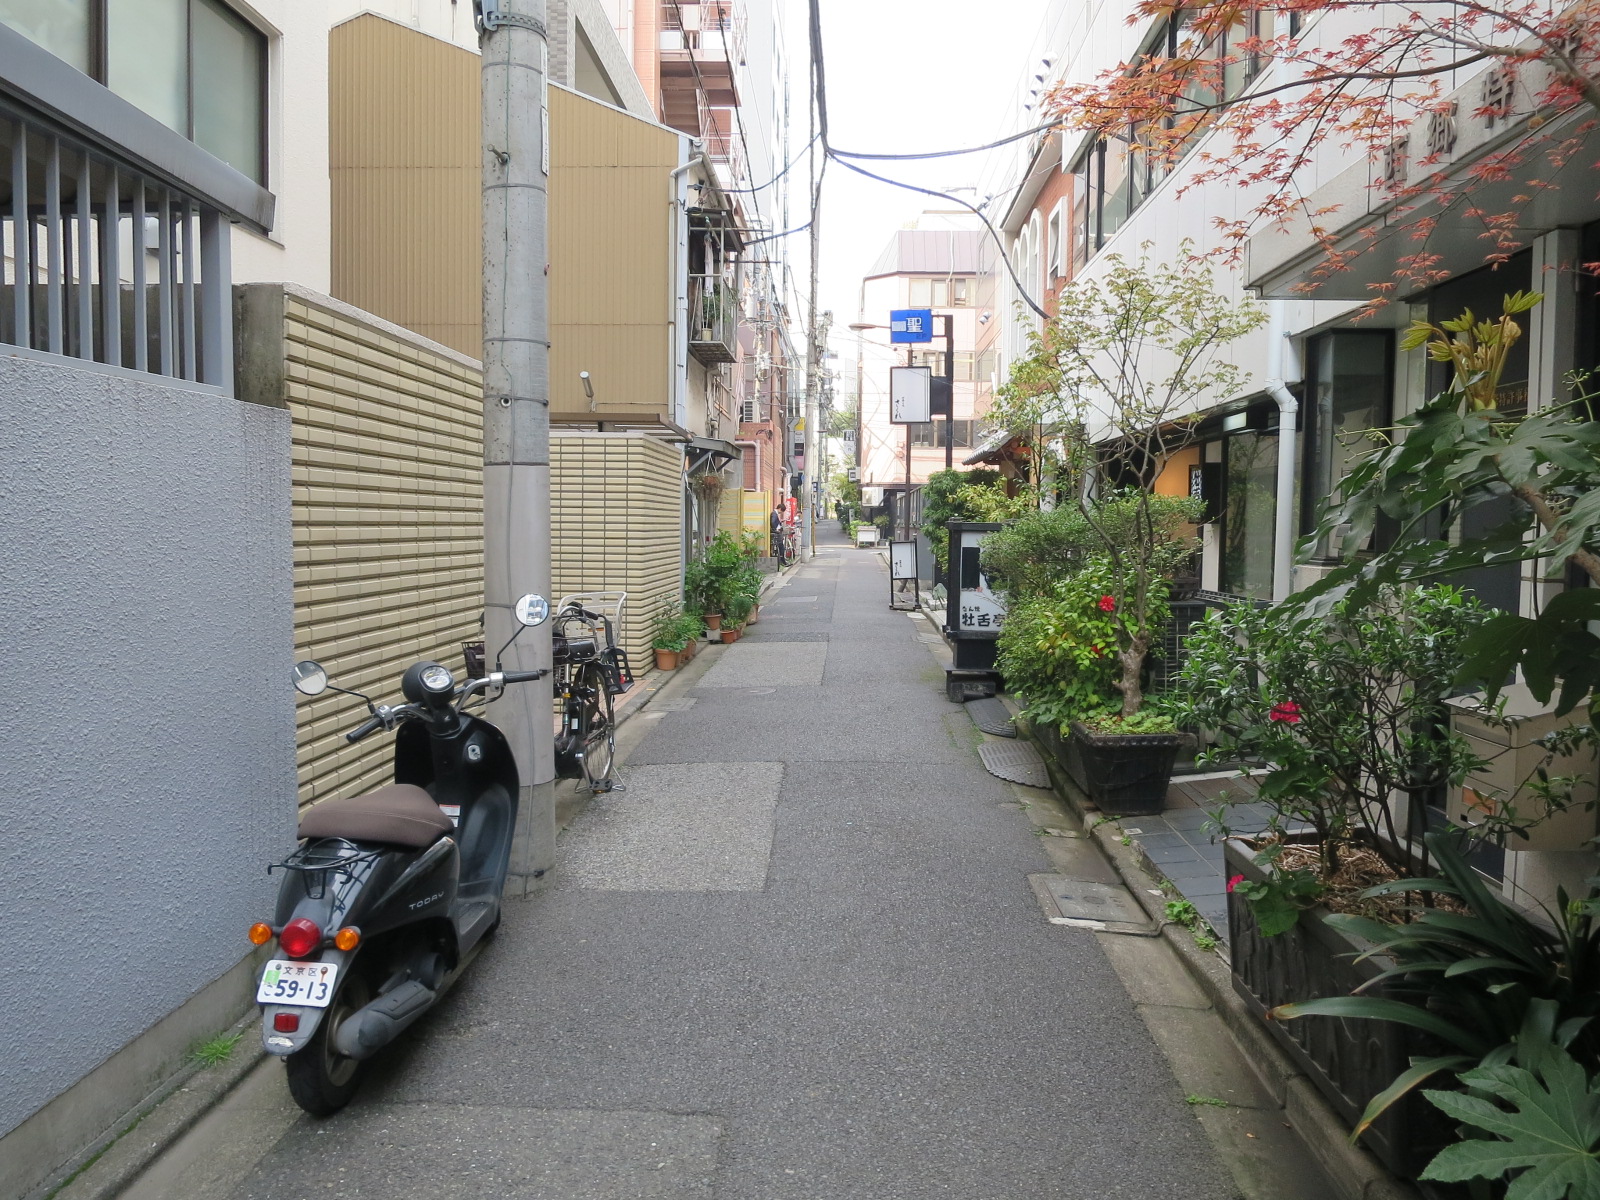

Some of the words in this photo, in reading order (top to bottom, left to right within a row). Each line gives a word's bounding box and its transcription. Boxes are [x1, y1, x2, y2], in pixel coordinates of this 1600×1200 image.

[906, 317, 923, 333] 聖
[283, 966, 318, 976] 文京区
[274, 979, 328, 1001] 59-13
